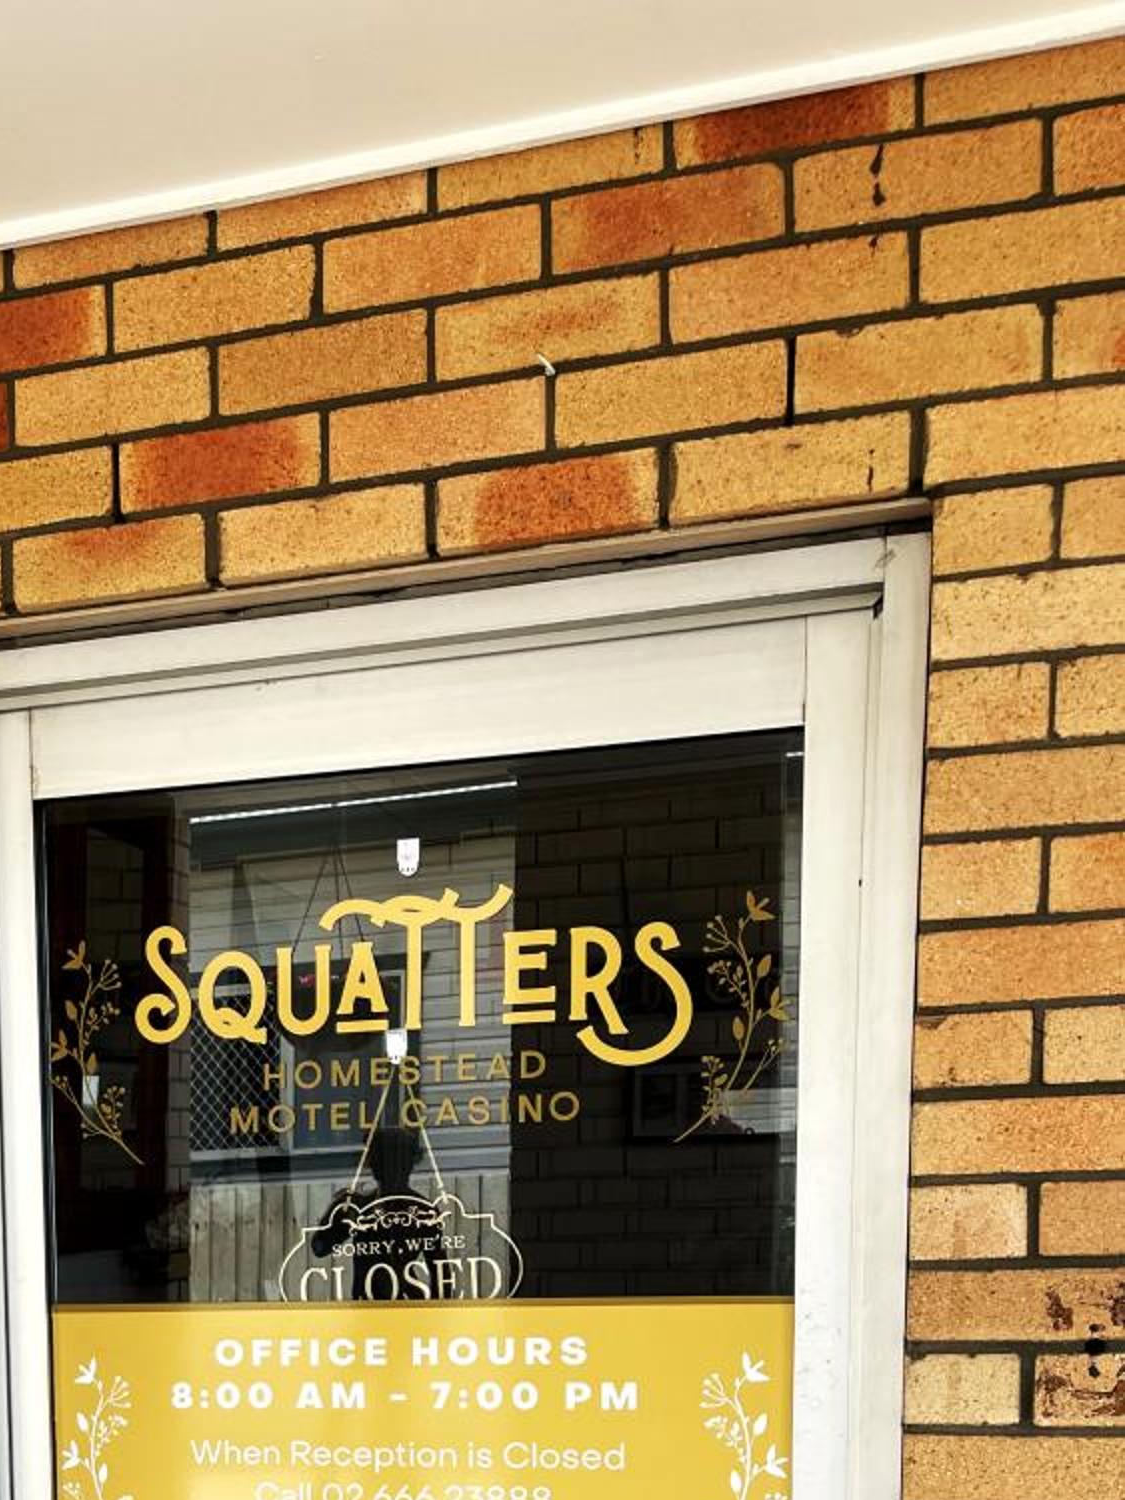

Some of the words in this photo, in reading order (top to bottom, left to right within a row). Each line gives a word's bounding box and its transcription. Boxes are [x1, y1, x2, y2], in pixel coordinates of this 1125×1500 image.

[134, 884, 693, 1066] SQUATTERS
[262, 1051, 546, 1090] HOMESTEAD
[229, 1100, 377, 1134] MOTEL
[401, 1091, 581, 1128] CASINO
[405, 1234, 466, 1251] WE'RE
[214, 1338, 388, 1367] OFFICE
[412, 1336, 590, 1366] HOURS
[171, 1382, 274, 1410] 8:00
[295, 1382, 367, 1410] AM
[430, 1382, 540, 1410] 7:00
[565, 1382, 639, 1410] PM
[191, 1440, 280, 1467] When
[290, 1440, 458, 1473] Reception
[467, 1442, 492, 1468] is
[503, 1442, 626, 1471] Closed
